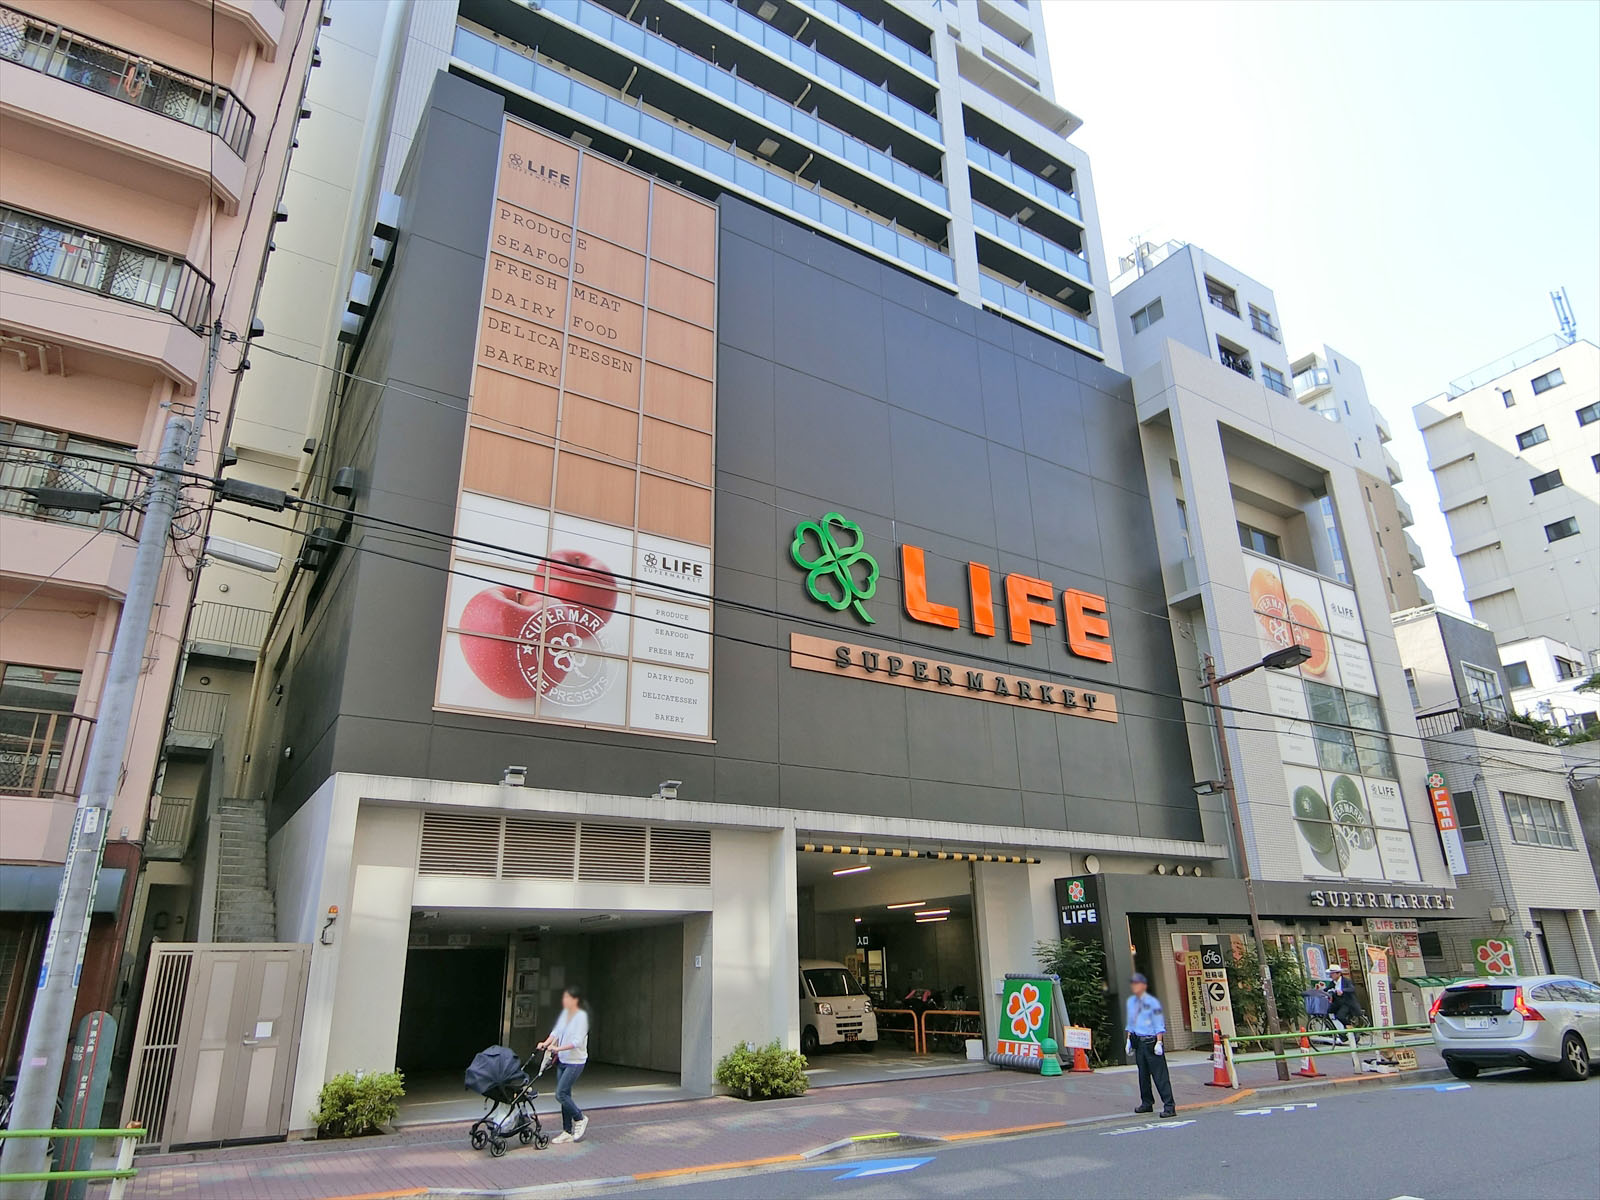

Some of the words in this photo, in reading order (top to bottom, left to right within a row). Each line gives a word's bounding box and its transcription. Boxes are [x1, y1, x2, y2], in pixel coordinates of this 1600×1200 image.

[528, 160, 570, 186] LIFE
[500, 208, 587, 251] PRODUCE
[497, 234, 585, 275] SEAFOOD
[494, 258, 558, 291] FRESH
[573, 287, 621, 313] MEAT
[491, 288, 556, 319] DAIRY
[573, 316, 618, 340] FOOD
[487, 316, 633, 374] DELICATESSEN
[484, 345, 560, 379] BAKERY
[662, 556, 703, 577] LIFE
[901, 543, 1113, 663] LIFE
[1337, 605, 1355, 618] LIFE
[655, 608, 689, 621] PRODUCE
[655, 628, 689, 640] SEAFOOD
[648, 646, 673, 656] FRESH
[675, 650, 695, 660] MEAT
[647, 671, 673, 683] DAIRY
[674, 676, 694, 685] FOOD
[835, 646, 1097, 712] SUPERMARKET
[548, 675, 609, 703] PRESENTS
[642, 691, 698, 705] DELICATESSEN
[655, 713, 685, 723] BAKERY
[1377, 785, 1395, 797] LIFE
[1433, 789, 1453, 830] LIFE
[1312, 890, 1456, 910] SUPERMARKET
[1062, 909, 1097, 924] LIFE
[1375, 920, 1394, 930] LIFE
[857, 936, 869, 946] 入口
[1004, 1042, 1040, 1058] LIFE
